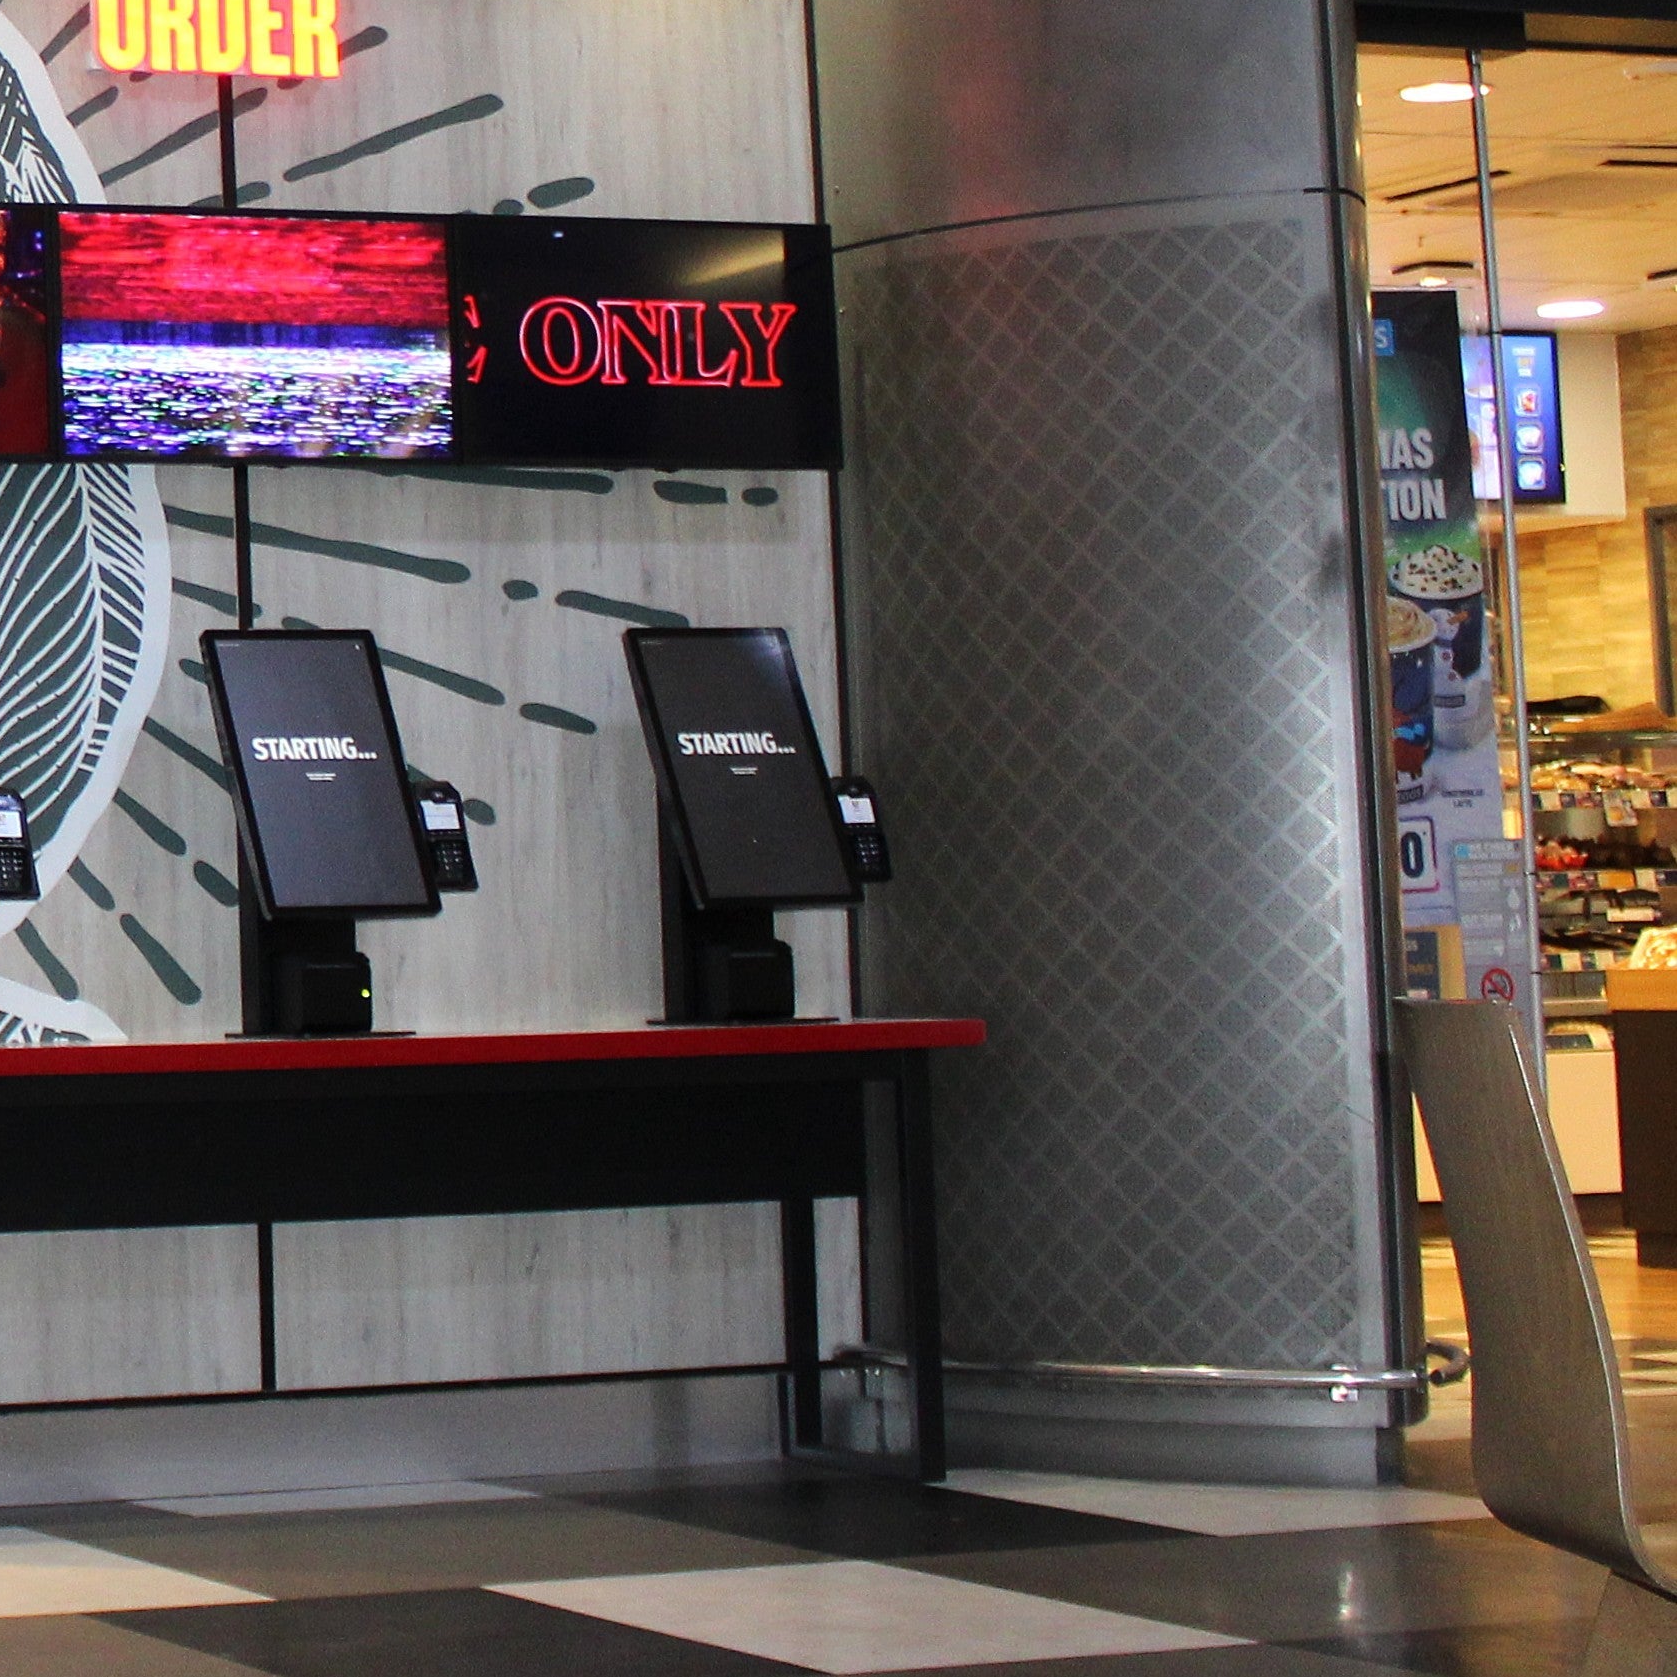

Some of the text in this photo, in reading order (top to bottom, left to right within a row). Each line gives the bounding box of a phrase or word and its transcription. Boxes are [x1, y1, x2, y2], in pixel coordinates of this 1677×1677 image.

[519, 295, 797, 389] ONLY
[1381, 478, 1447, 521] ION
[251, 736, 378, 761] STARTING...
[677, 732, 797, 756] STARTING...
